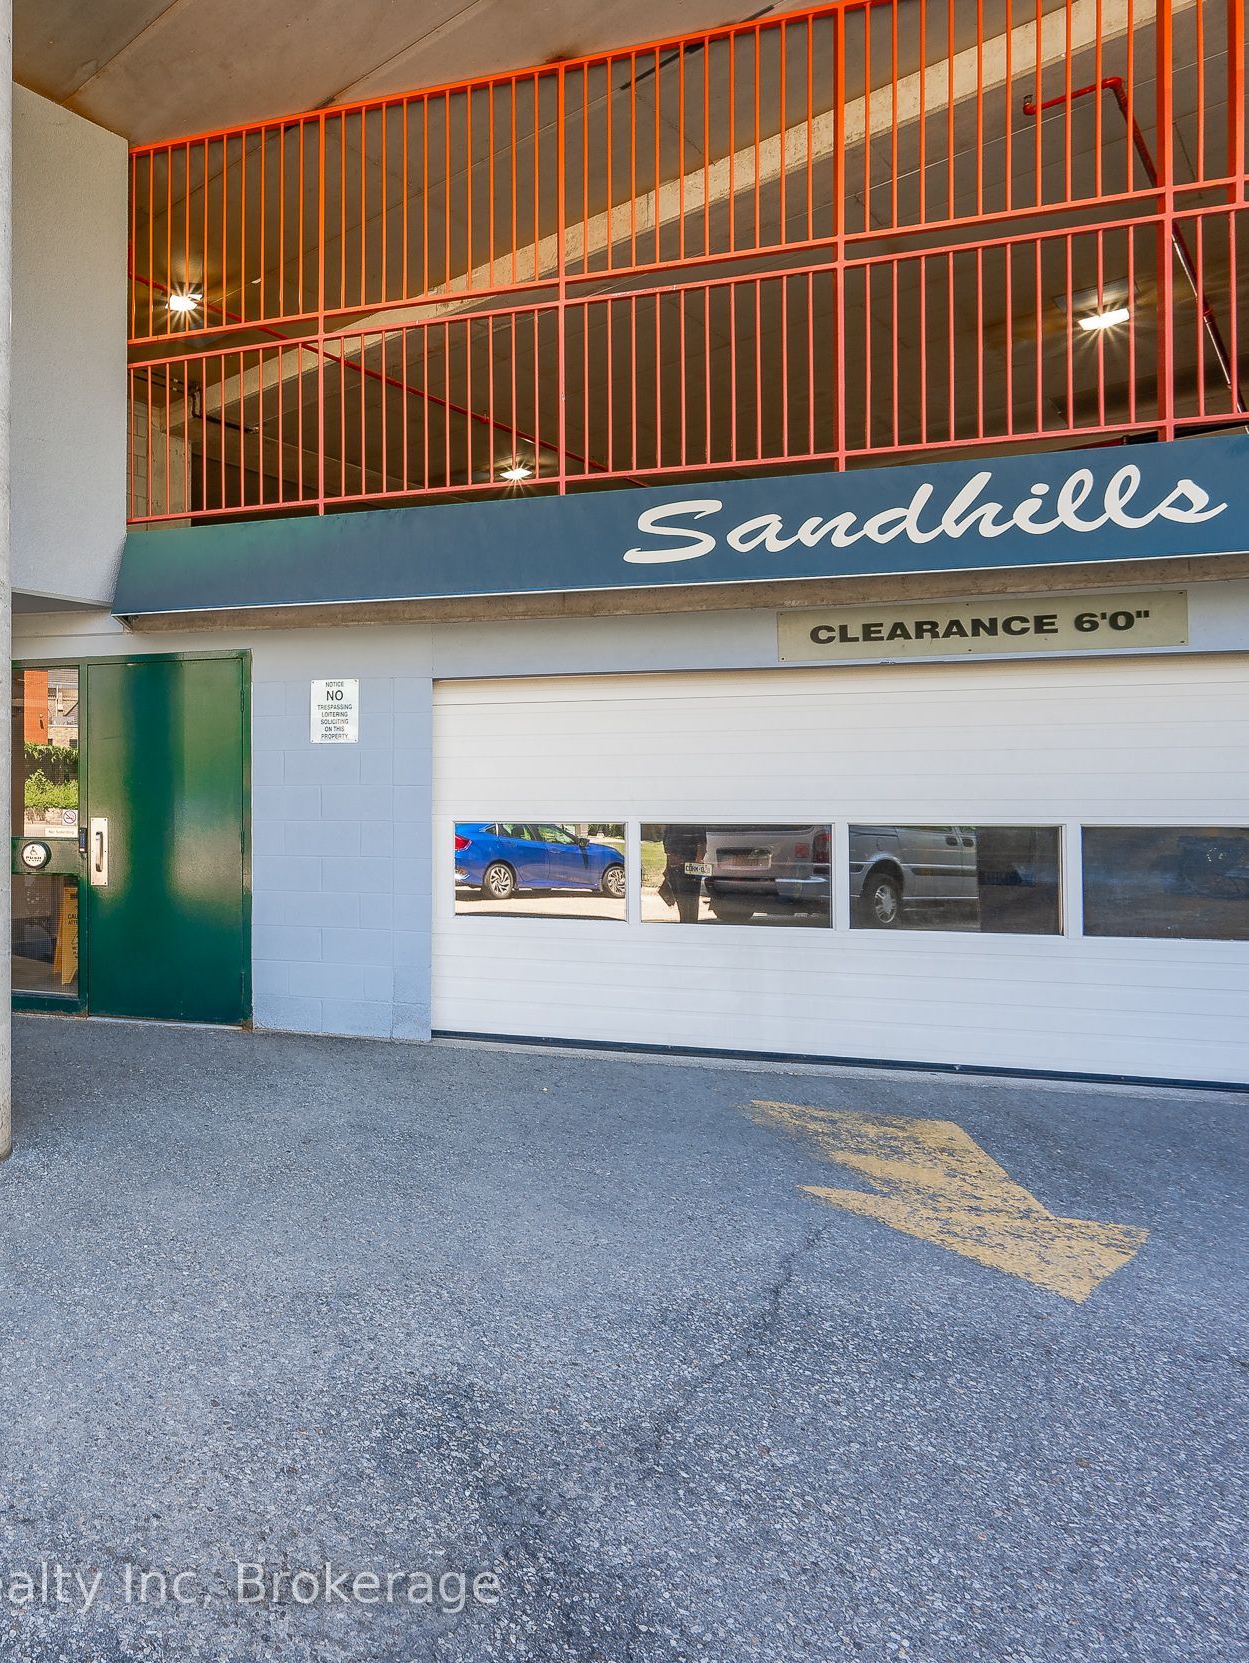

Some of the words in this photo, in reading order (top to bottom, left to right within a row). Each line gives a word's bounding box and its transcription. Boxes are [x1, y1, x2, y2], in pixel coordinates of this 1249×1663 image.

[623, 464, 1228, 563] Sandhills
[810, 614, 1058, 645] CLEARANCE
[1074, 610, 1150, 632] 6'0"
[326, 690, 344, 701] NO
